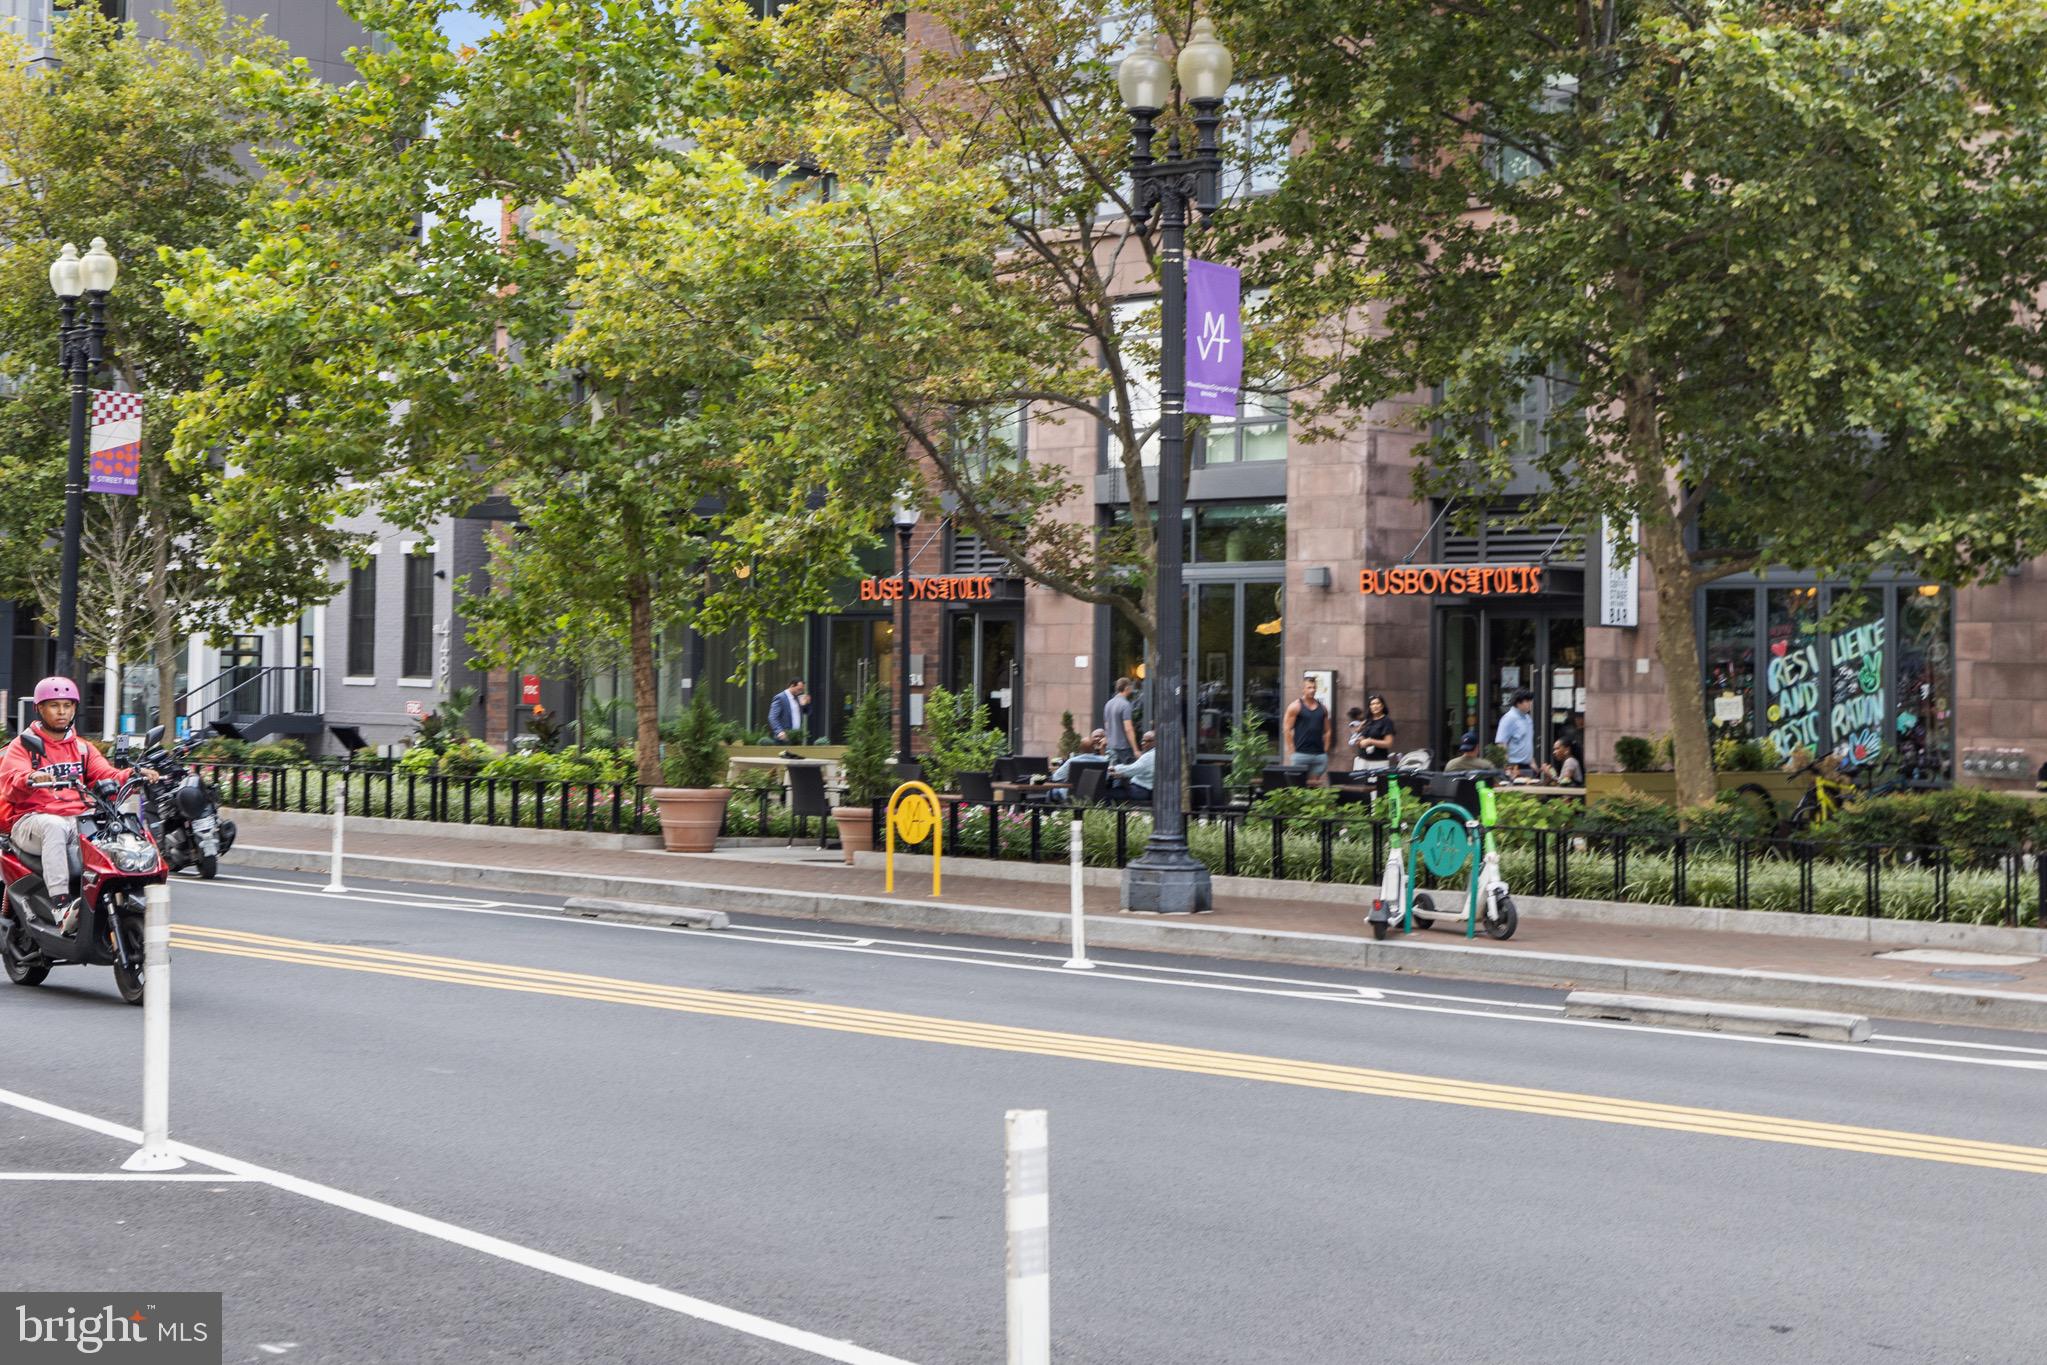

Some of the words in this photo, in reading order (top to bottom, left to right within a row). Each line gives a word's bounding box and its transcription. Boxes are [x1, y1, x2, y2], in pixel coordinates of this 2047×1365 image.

[97, 476, 123, 484] STREET
[949, 576, 993, 600] POETS
[1360, 568, 1467, 595] BUSBOYS
[1466, 568, 1482, 594] AND
[1481, 567, 1541, 595] POETS
[1780, 682, 1819, 718] AND
